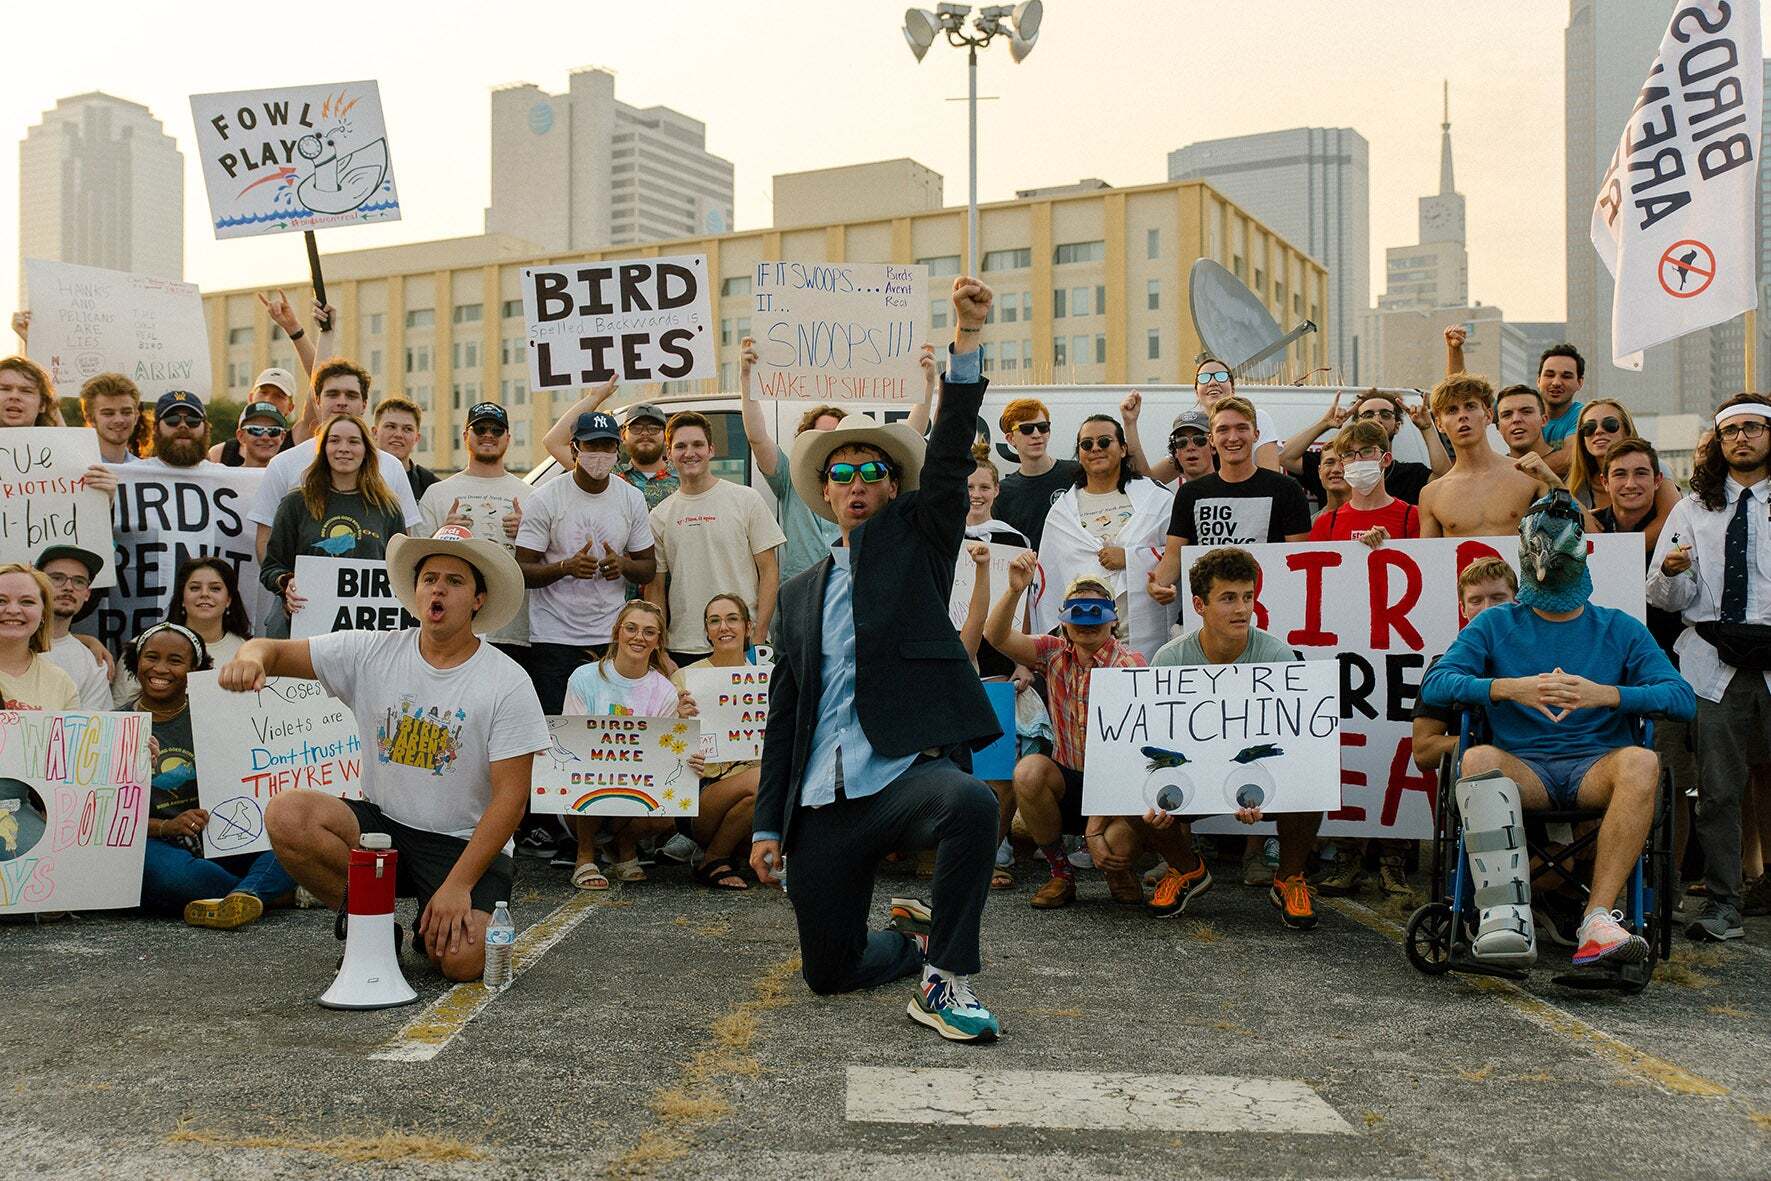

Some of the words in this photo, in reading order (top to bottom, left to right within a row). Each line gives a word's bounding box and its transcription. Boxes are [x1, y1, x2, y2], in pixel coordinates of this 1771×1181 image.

[211, 101, 313, 141] FOWL
[218, 140, 298, 179] PLAY
[757, 263, 770, 287] IF
[775, 262, 787, 286] IT
[886, 265, 913, 282] Birds
[70, 299, 97, 311] AND
[885, 296, 908, 307] Real
[58, 309, 115, 324] PELICANS
[72, 323, 103, 336] ARE
[530, 321, 584, 340] Spelled
[595, 314, 679, 334] Backwards
[66, 336, 101, 348] LIES
[757, 371, 811, 398] WAKE
[816, 375, 838, 398] UP
[0, 444, 53, 474] ue
[116, 481, 244, 538] IRDS
[1200, 505, 1232, 521] BIG
[1200, 522, 1237, 537] GOV
[337, 567, 398, 598] BIR
[1121, 664, 1309, 698] THEY'RE
[1293, 650, 1428, 722] RE
[251, 716, 313, 745] Violets
[322, 711, 344, 725] are
[586, 719, 648, 731] BIRDS
[1097, 695, 1339, 744] WATCHING
[601, 732, 641, 745] ARE
[298, 739, 345, 766] trust
[590, 748, 644, 762] MAKE
[571, 772, 655, 788] BELIEVE
[1326, 731, 1439, 827] EA
[52, 785, 142, 854] BOTH
